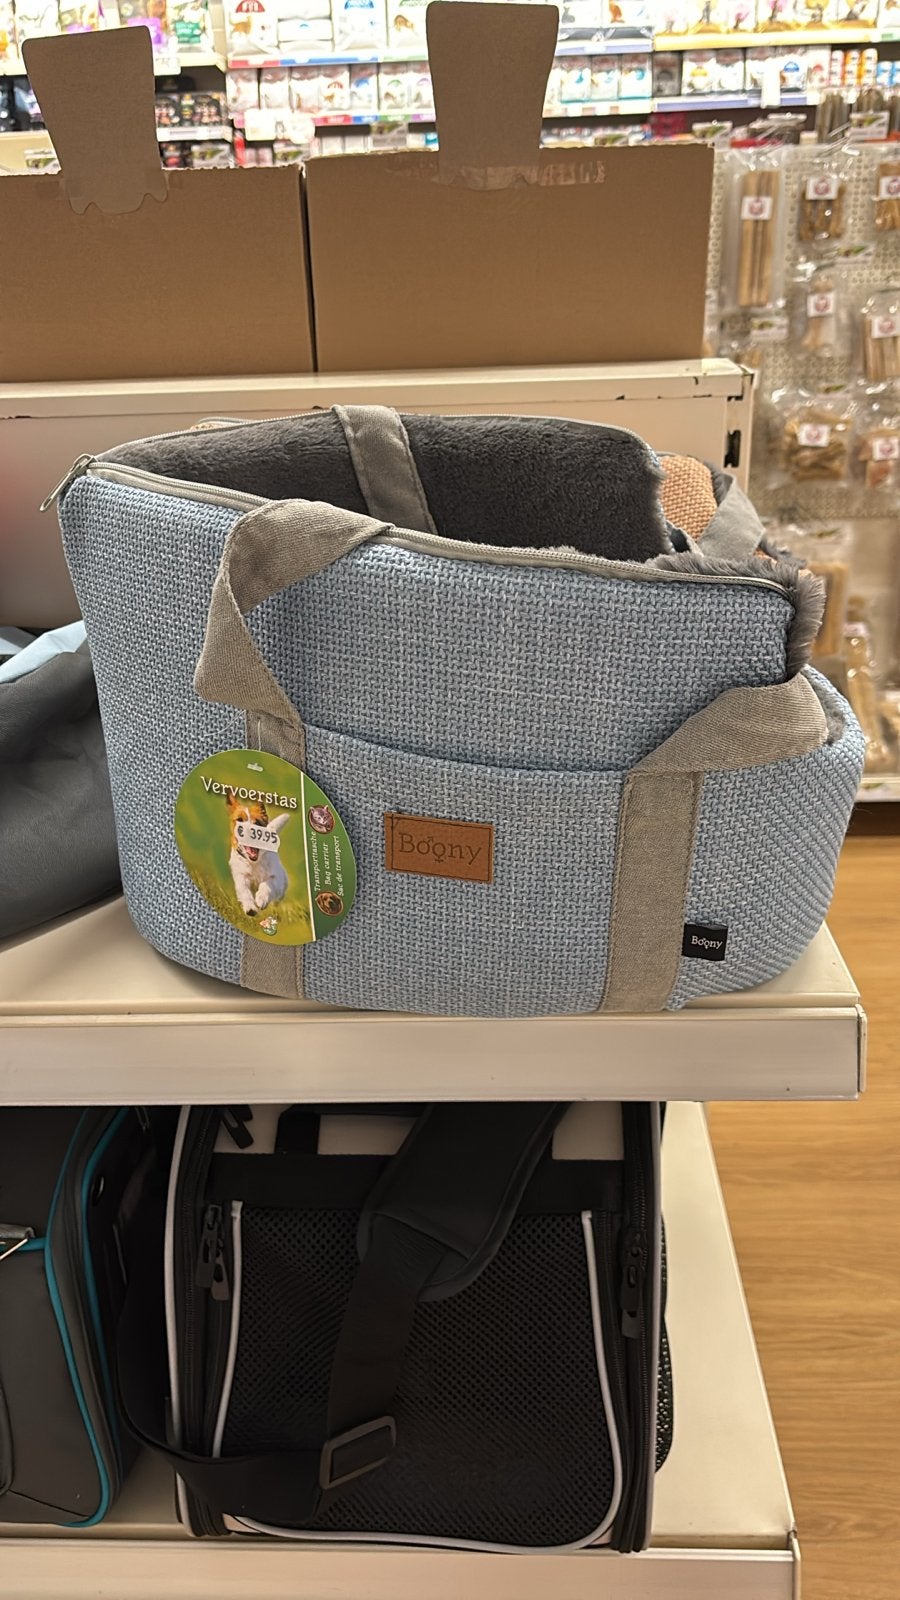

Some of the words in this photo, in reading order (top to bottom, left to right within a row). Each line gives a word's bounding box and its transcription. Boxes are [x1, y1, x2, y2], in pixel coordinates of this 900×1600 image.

[200, 776, 298, 809] Vervoerstas
[237, 825, 244, 837] €
[250, 827, 278, 844] 39.95
[311, 831, 321, 892] Transporttasche
[333, 835, 341, 871] transport
[398, 832, 482, 866] Boony
[335, 872, 343, 883] de
[337, 883, 345, 897] Sac
[691, 935, 723, 950] Boony
